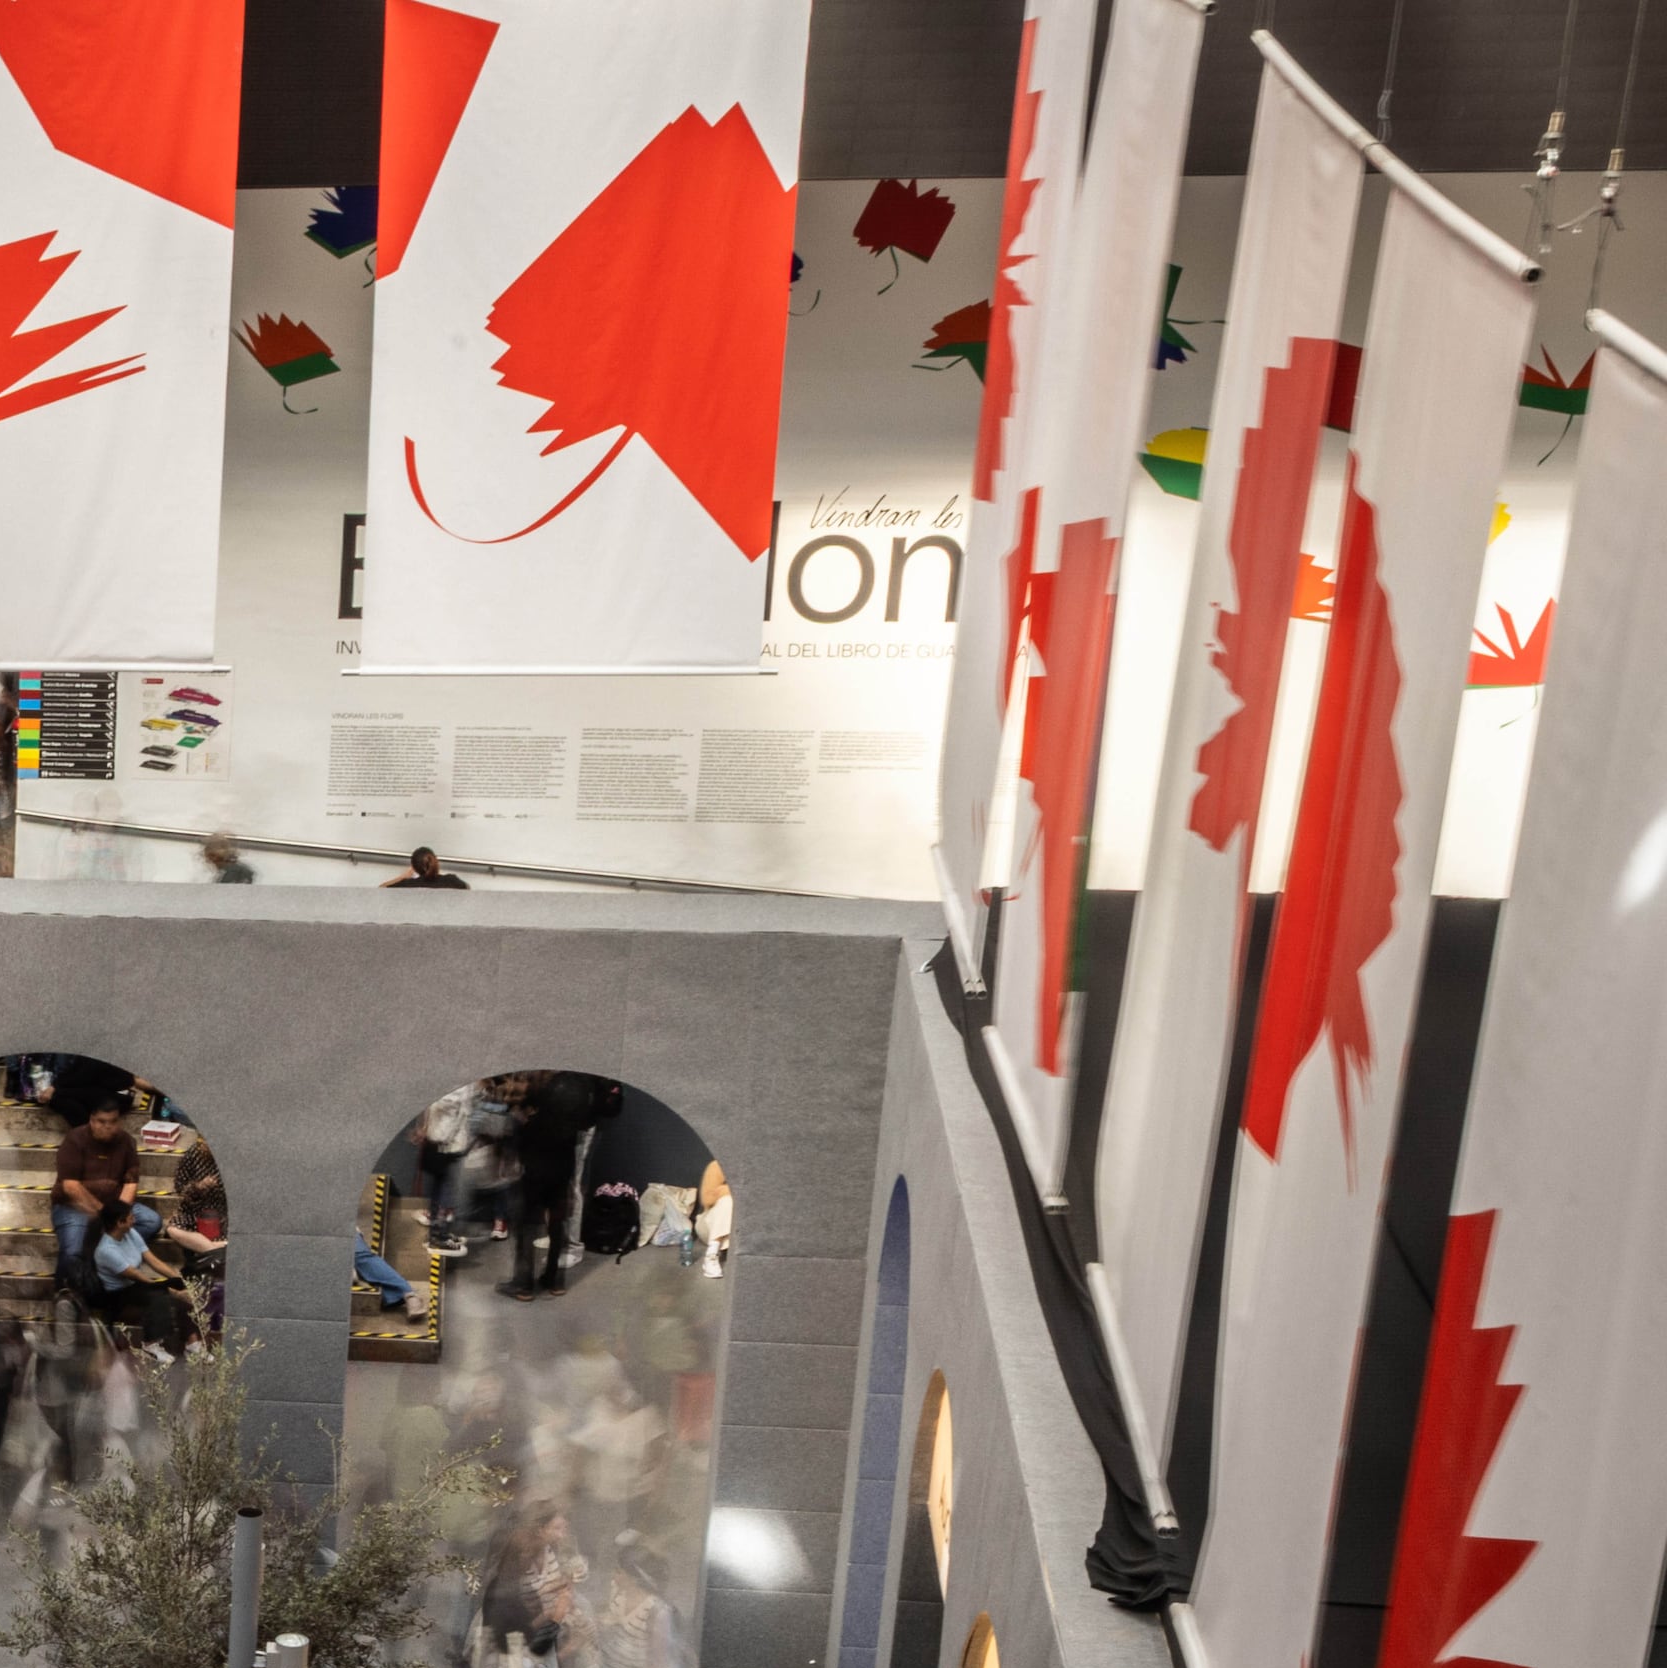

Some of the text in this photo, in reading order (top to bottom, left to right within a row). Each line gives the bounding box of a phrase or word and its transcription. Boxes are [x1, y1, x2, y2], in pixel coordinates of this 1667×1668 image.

[810, 485, 922, 529] Vindran
[787, 643, 821, 658] DEL
[826, 643, 881, 658] LIBRO
